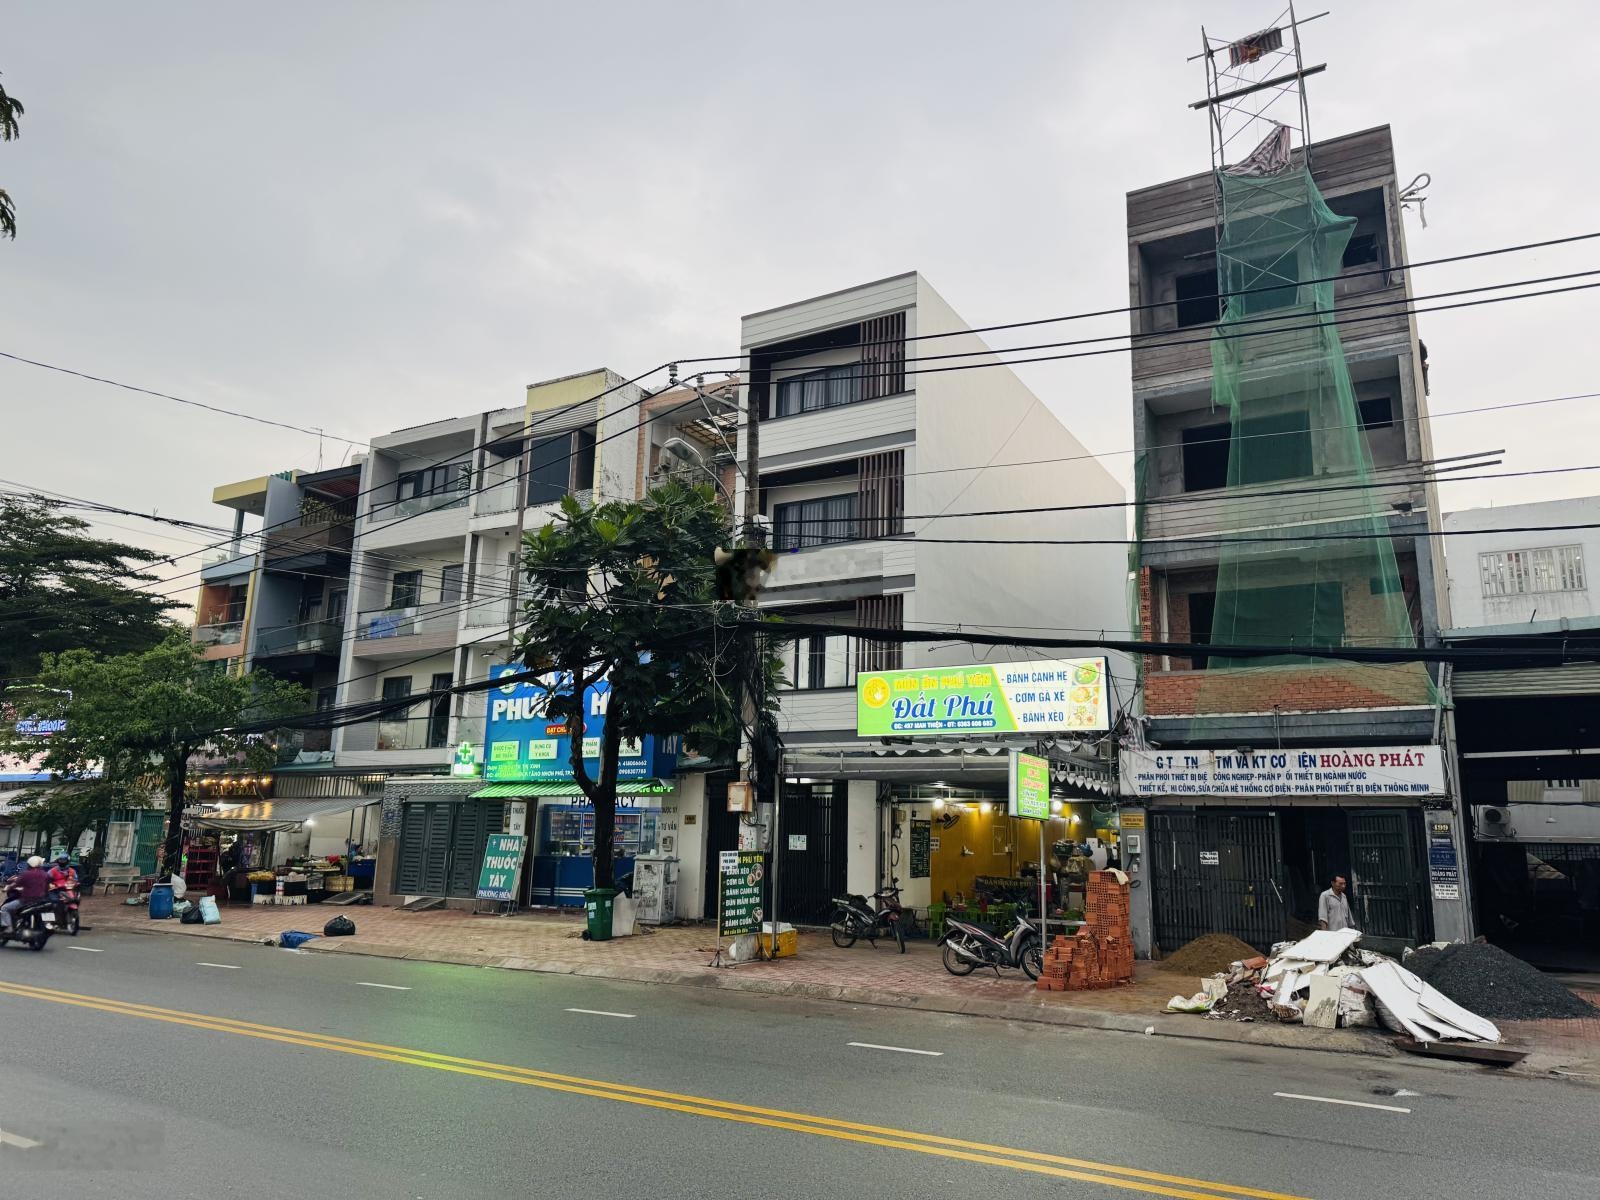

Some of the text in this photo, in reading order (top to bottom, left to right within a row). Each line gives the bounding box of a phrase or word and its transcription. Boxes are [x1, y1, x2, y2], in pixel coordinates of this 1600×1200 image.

[1007, 671, 1029, 683] BÁNH
[1032, 671, 1054, 682] CANH
[1016, 692, 1036, 703] CƠM
[1039, 690, 1050, 702] GÀ
[892, 691, 994, 719] Đất Phú
[1023, 711, 1064, 723] BÁNH XÈO
[1216, 755, 1232, 769] TM
[1252, 755, 1267, 768] KT
[1270, 753, 1287, 768] CƠ
[1298, 752, 1317, 770] IỆN
[1320, 750, 1376, 768] HOÀNG
[1379, 749, 1425, 767] PHÁT
[1172, 768, 1188, 781] THIẾT
[1294, 768, 1313, 781] THIẾT
[1323, 770, 1347, 780] NGÀNH
[1348, 768, 1367, 780] NƯỚC
[1139, 782, 1157, 792] THIẾT
[1241, 781, 1263, 792] THỐNG
[1275, 783, 1291, 793] ĐIỆN
[1295, 783, 1314, 792] PHÂN
[1316, 780, 1332, 792] PHỐI
[1333, 781, 1354, 792] THIẾT
[1356, 784, 1364, 793] BỊ
[1365, 783, 1382, 793] ĐIỆN
[1383, 783, 1409, 792] THÔNG
[1410, 783, 1430, 792] MINH
[499, 836, 519, 851] NHÀ
[486, 853, 518, 870] THUỐC
[489, 872, 507, 888] TÂY
